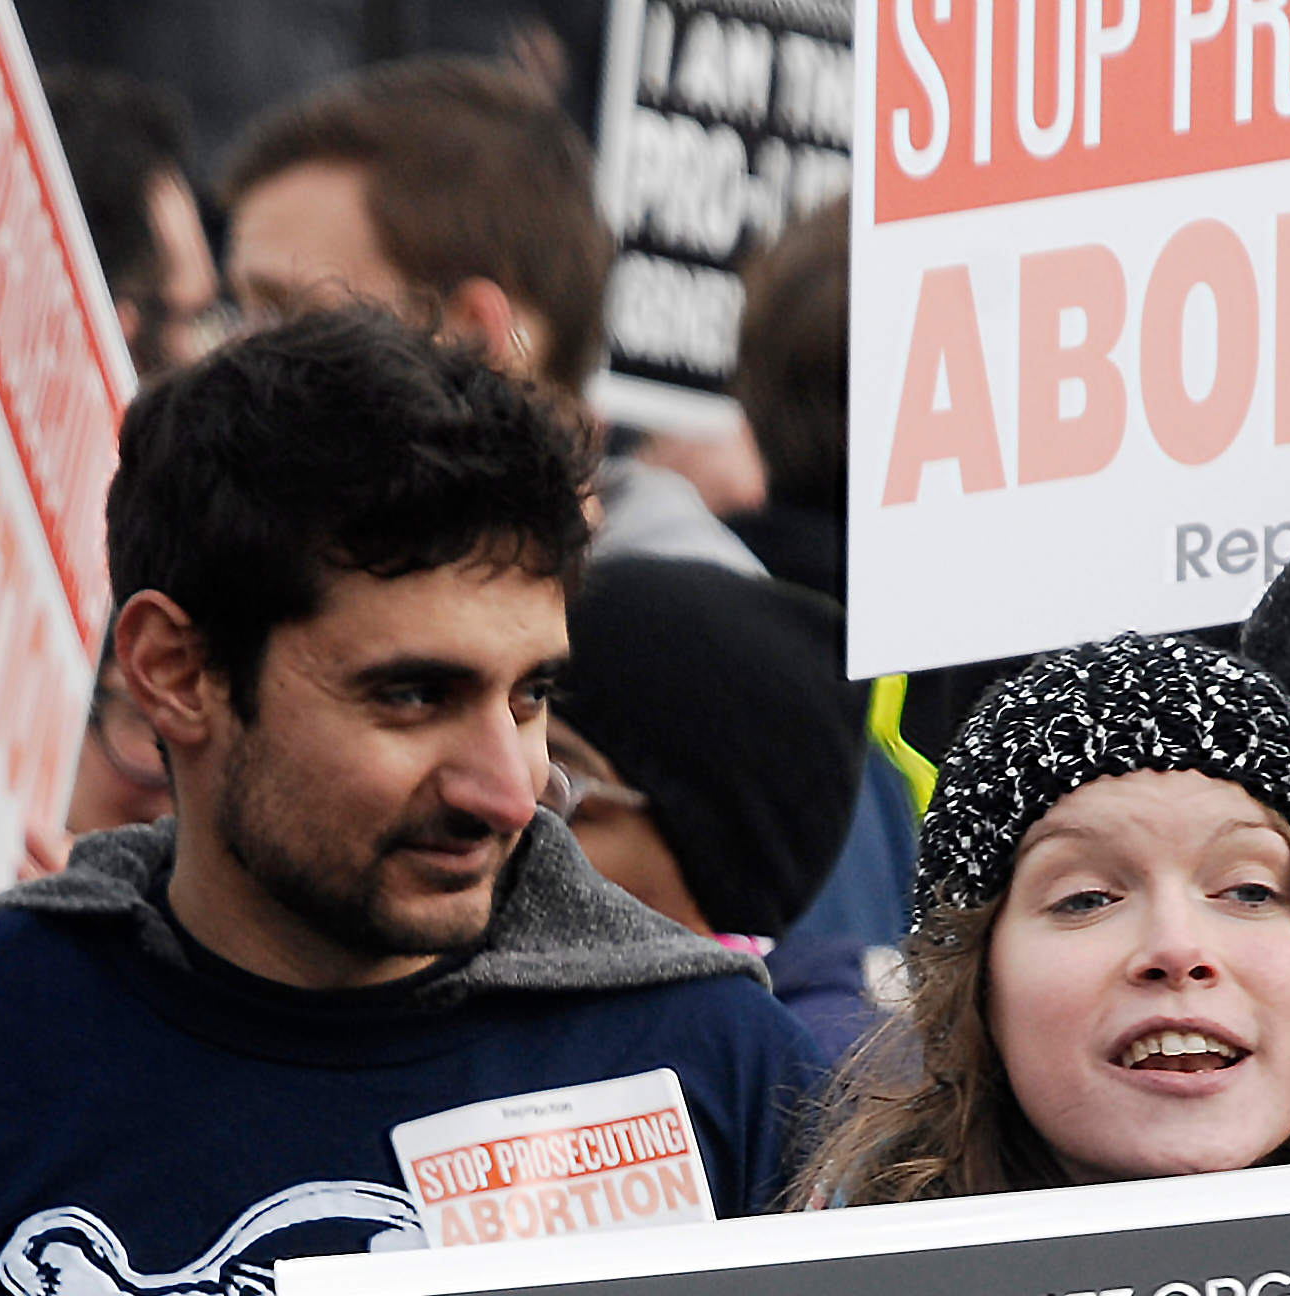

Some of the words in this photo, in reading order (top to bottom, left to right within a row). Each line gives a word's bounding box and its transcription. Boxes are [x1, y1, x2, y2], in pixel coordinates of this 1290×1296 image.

[419, 1145, 492, 1200] STOP
[499, 1111, 686, 1183] PROSECUTING
[440, 1162, 700, 1248] ABORTION
